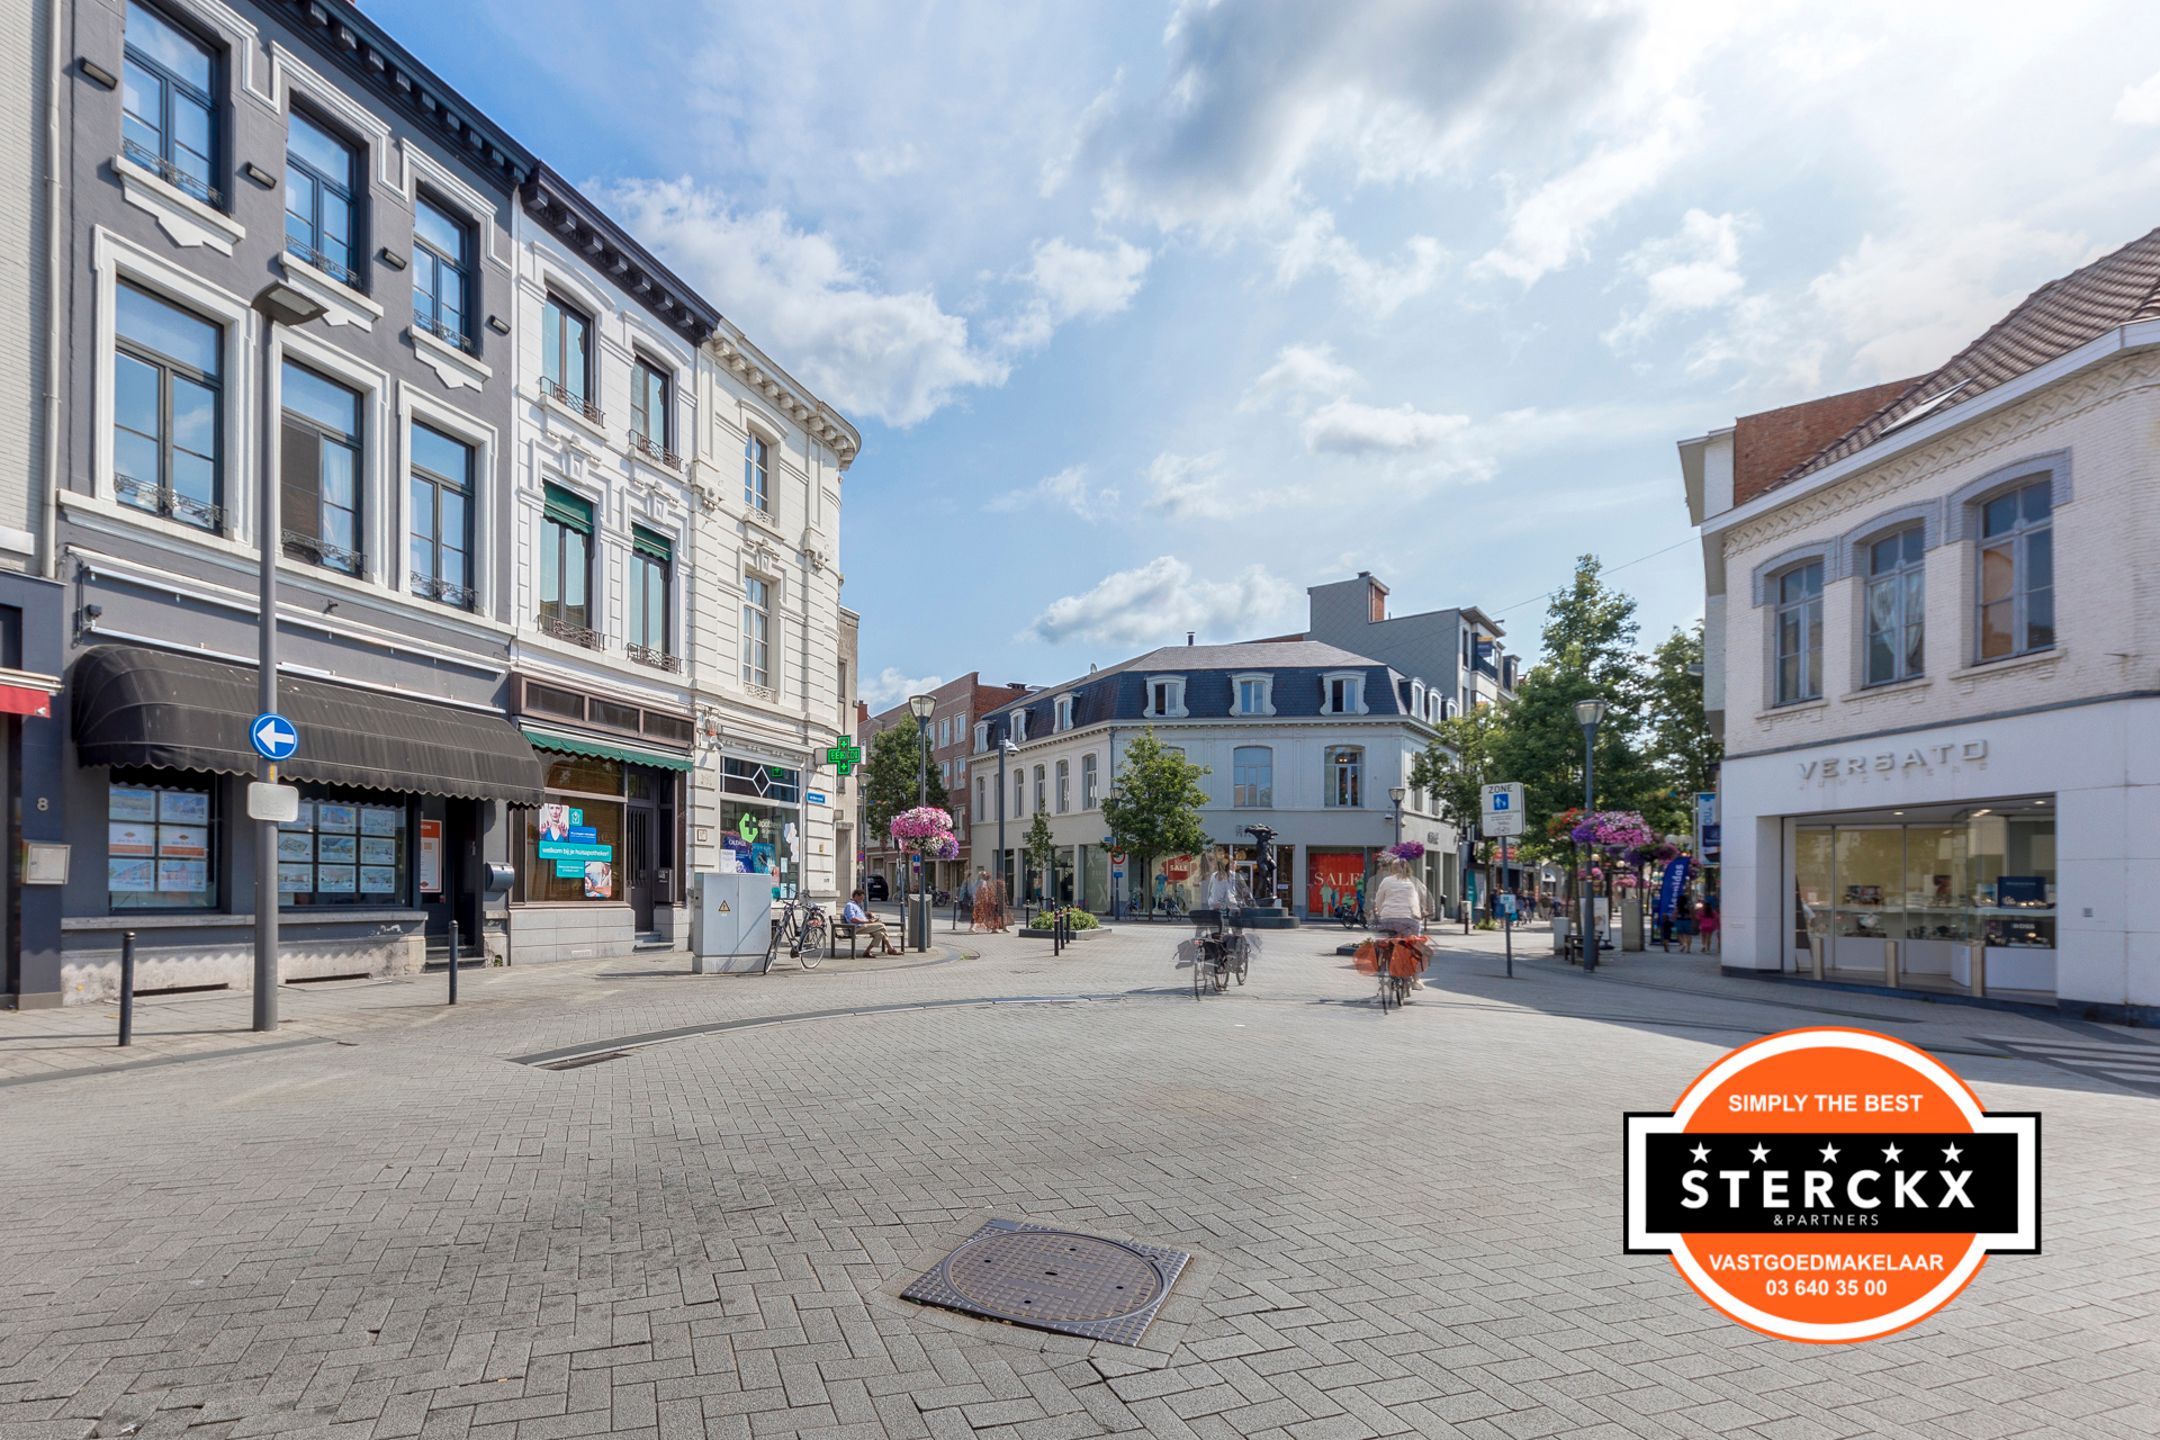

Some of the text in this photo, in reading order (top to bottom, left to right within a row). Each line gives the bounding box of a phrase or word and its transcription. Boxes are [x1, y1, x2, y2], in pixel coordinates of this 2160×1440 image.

[1799, 739, 1989, 780] VERSATO
[1488, 784, 1513, 793] ZONE
[37, 797, 49, 811] 8
